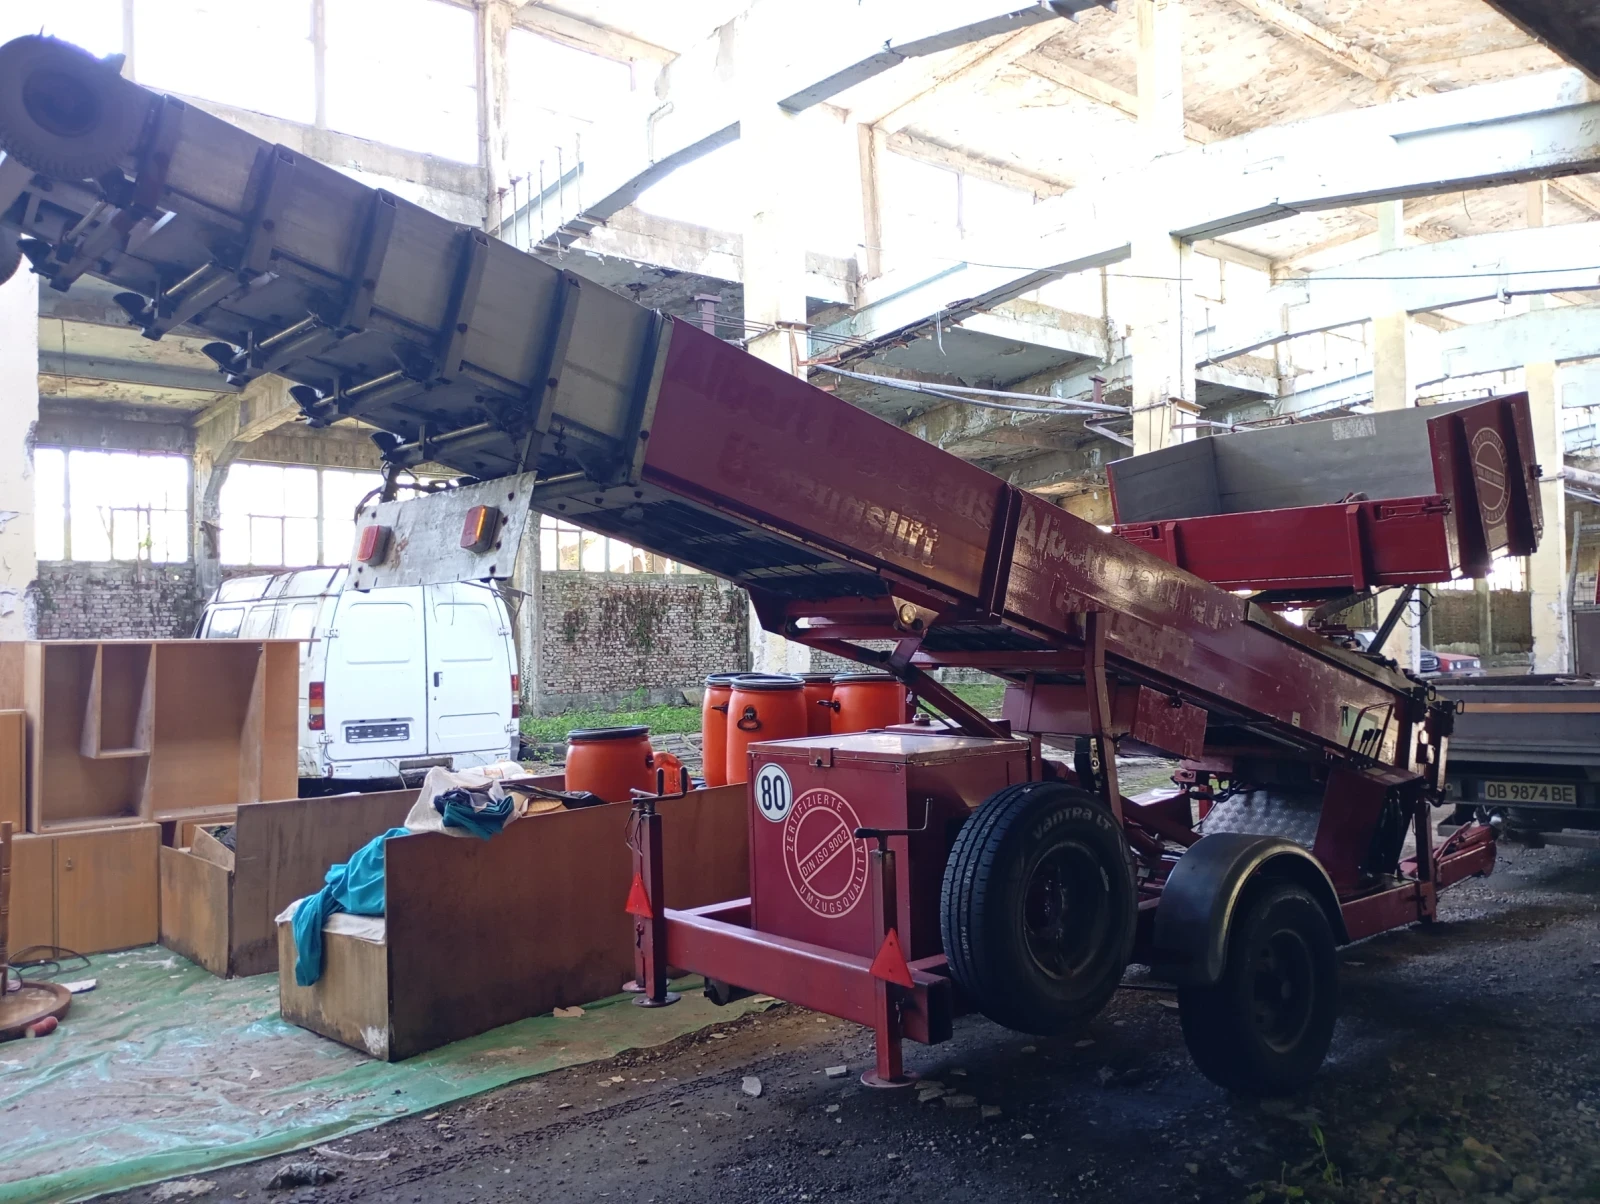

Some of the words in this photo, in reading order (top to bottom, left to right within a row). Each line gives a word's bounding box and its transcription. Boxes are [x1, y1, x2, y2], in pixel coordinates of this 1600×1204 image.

[761, 775, 786, 811] 80
[1487, 784, 1507, 798] OB
[1510, 785, 1549, 801] 9874
[1552, 788, 1573, 802] BE
[786, 793, 843, 852] ZERTIFIZIERTE
[1096, 814, 1112, 830] LT
[801, 860, 816, 877] DIN
[816, 846, 829, 865] ISO
[829, 829, 849, 853] 9002
